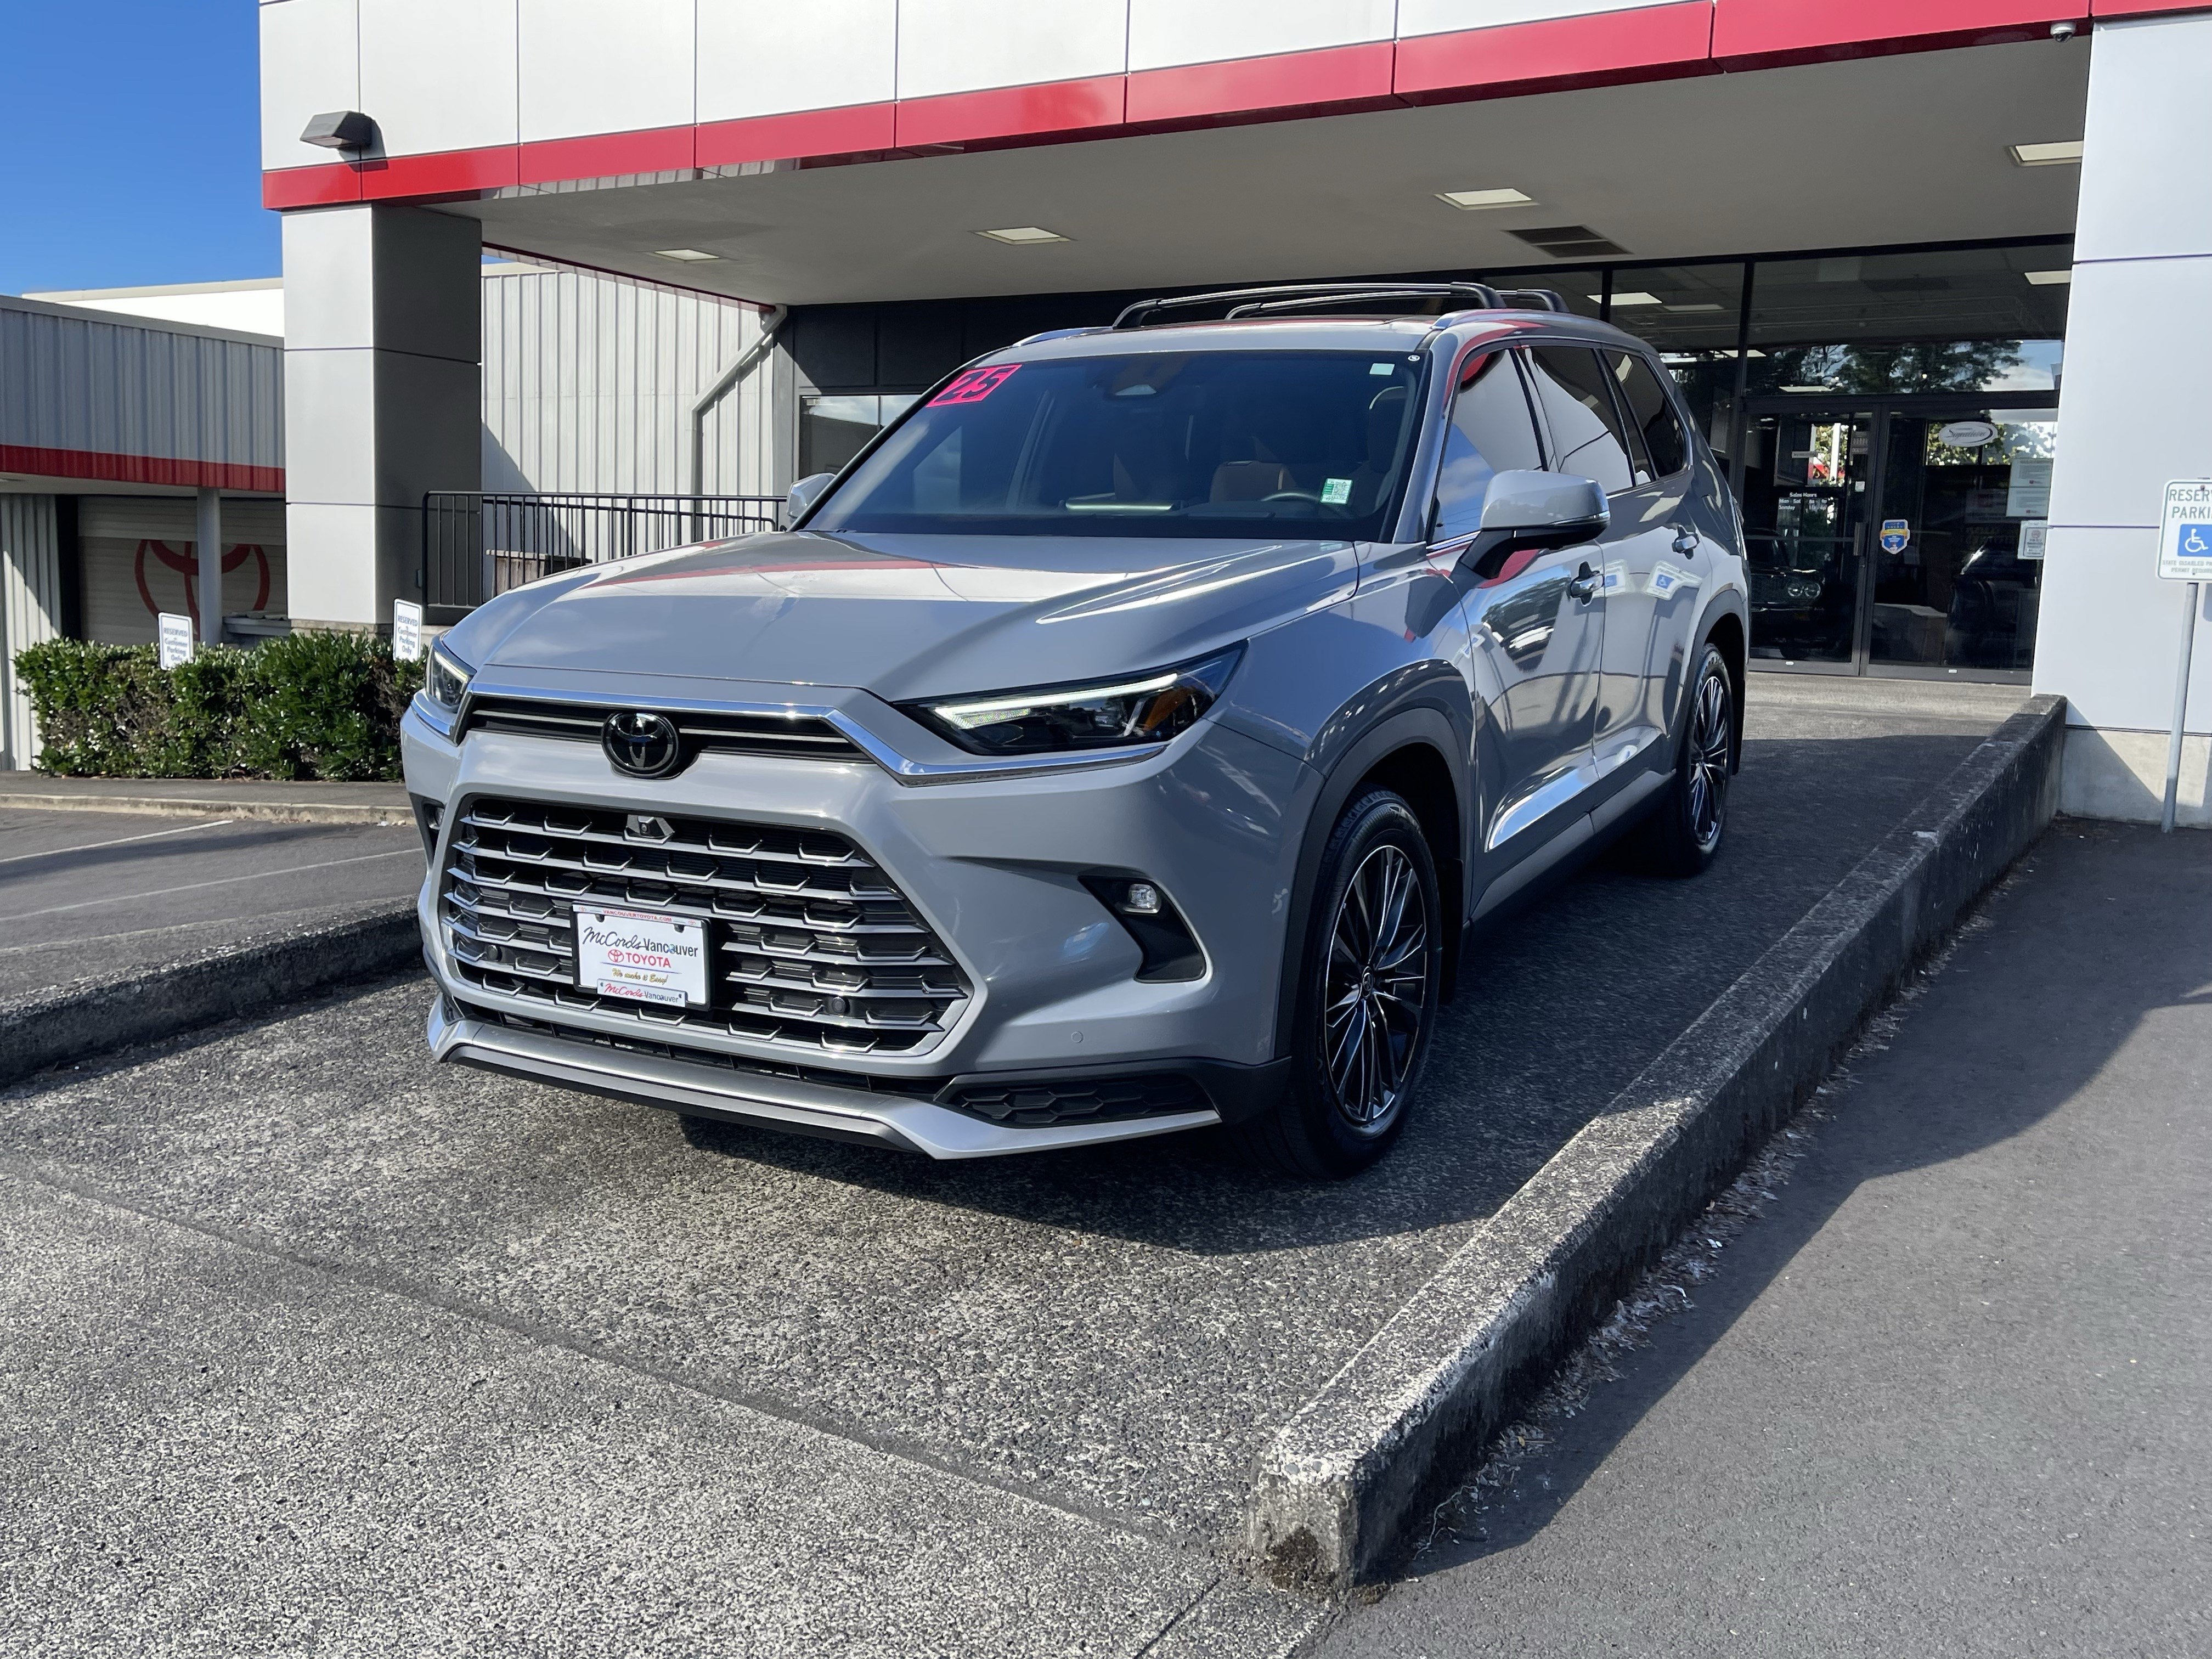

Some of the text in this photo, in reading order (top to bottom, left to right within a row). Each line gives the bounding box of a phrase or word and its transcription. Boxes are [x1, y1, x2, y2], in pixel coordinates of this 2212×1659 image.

[934, 368, 1015, 403] 25
[2169, 489, 2212, 501] RESER
[2172, 506, 2212, 518] PARKI
[603, 909, 672, 922] VANCOUVERTOYOTA.COM
[582, 926, 698, 957] McCords Vancouver
[625, 952, 672, 968] TOYOTA
[604, 983, 679, 1003] McCords Vancouver
